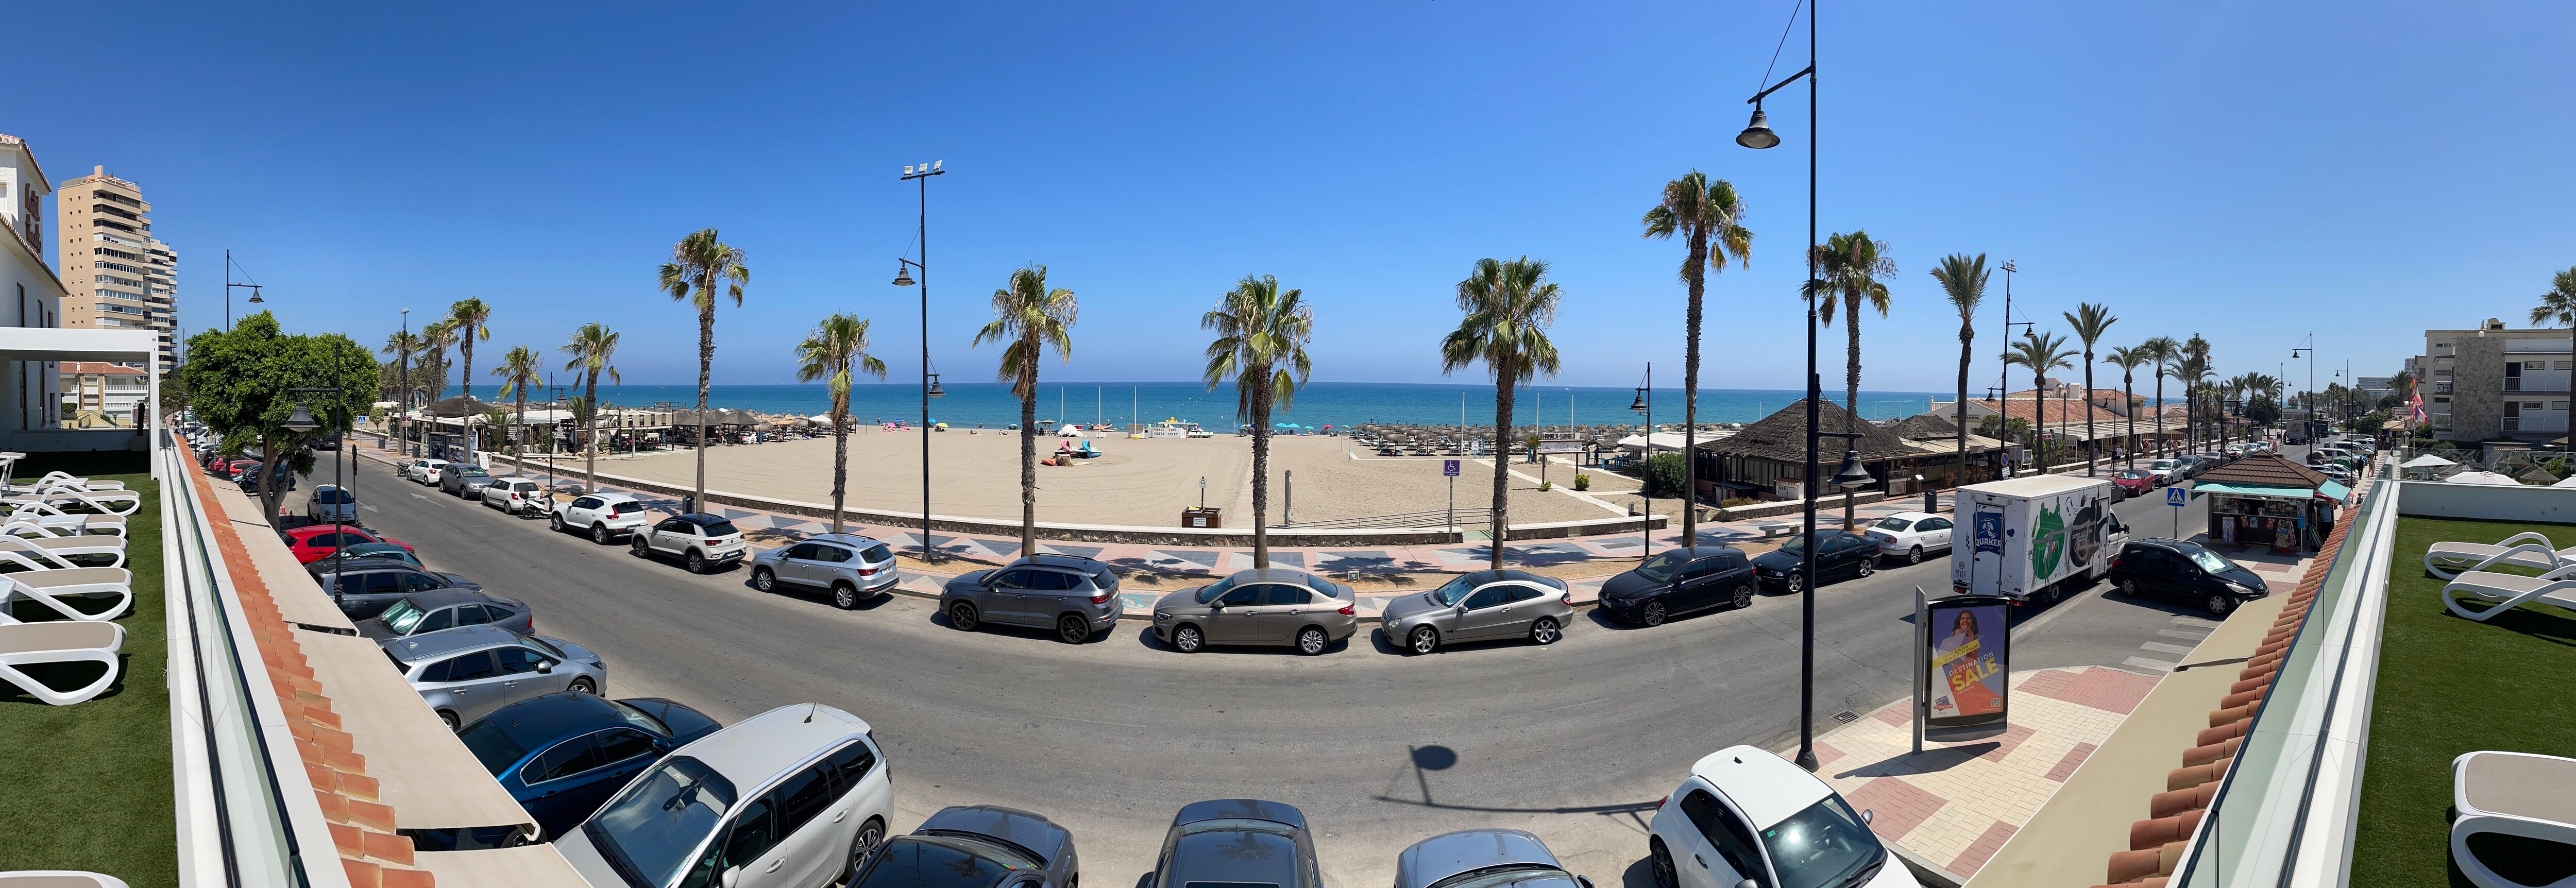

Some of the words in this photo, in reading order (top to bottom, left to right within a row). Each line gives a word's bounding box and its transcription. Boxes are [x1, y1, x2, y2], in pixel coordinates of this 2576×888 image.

[1976, 538, 2001, 548] QUAKER
[1948, 651, 1994, 677] DESTINATION
[1952, 657, 1999, 691] SALE
